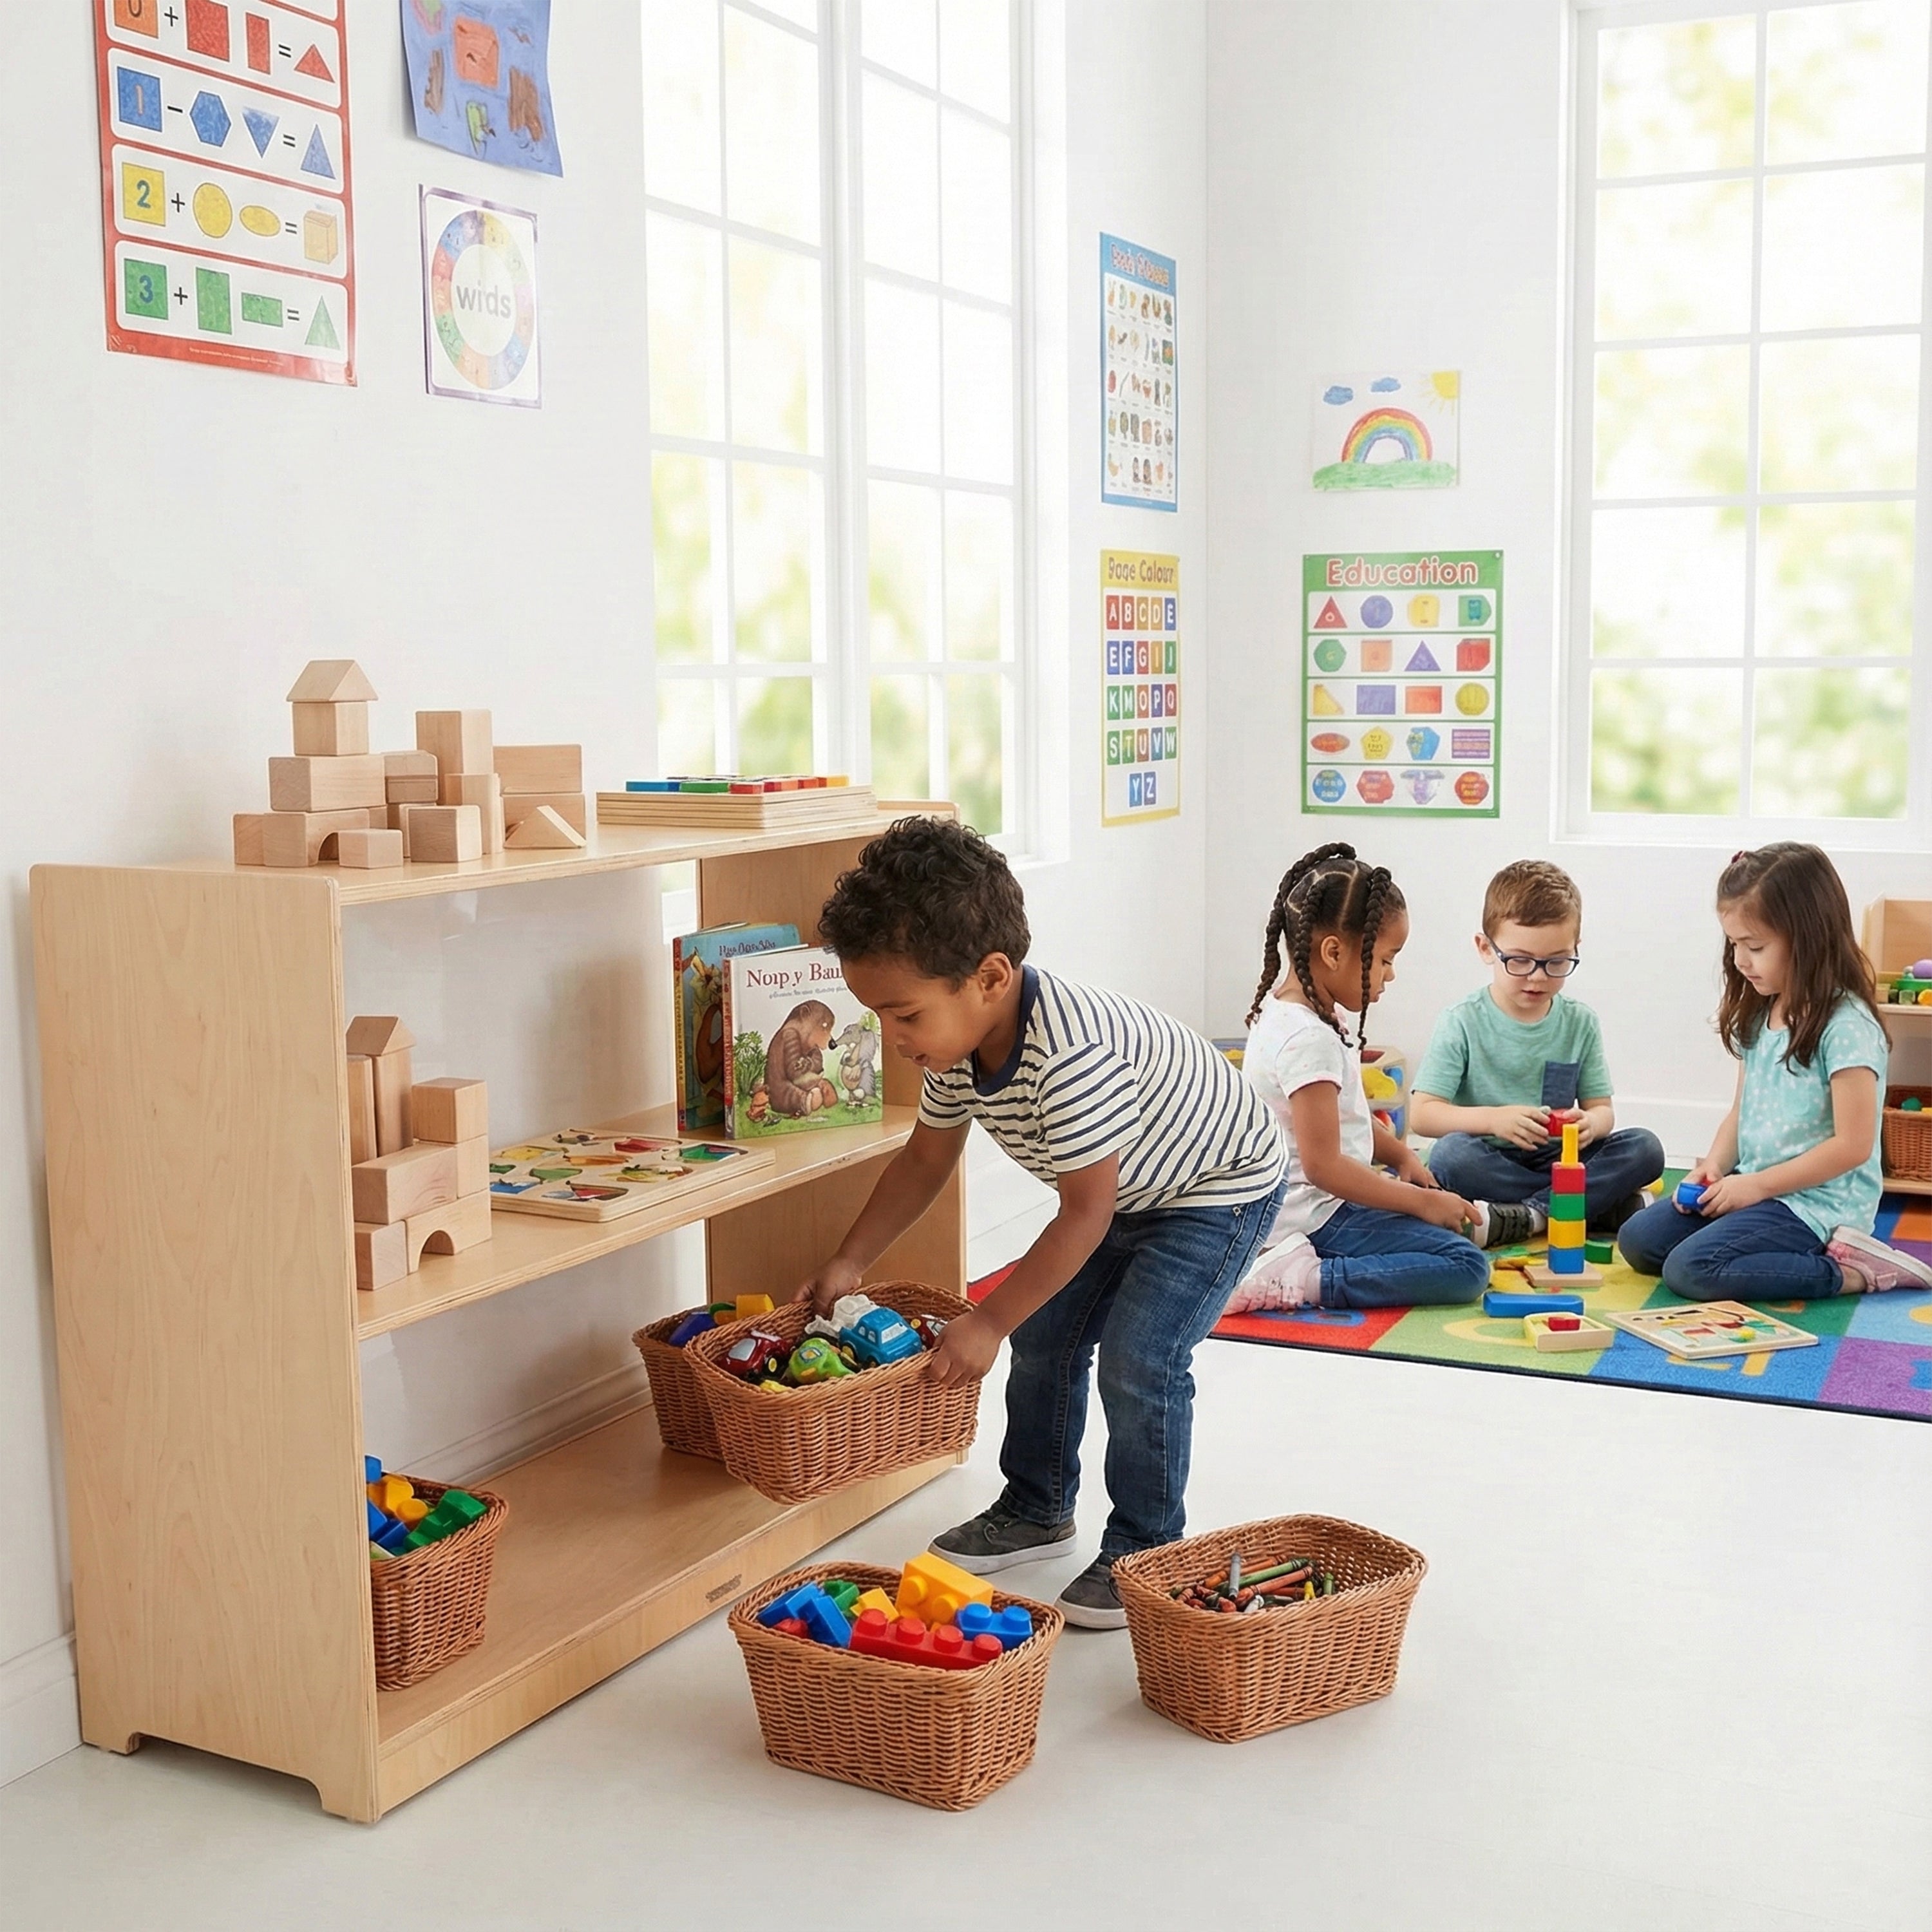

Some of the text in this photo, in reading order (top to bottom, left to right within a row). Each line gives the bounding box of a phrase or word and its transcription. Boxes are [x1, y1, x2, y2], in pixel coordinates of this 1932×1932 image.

[137, 180, 151, 209] 2
[139, 274, 154, 304] 3
[1327, 556, 1479, 587] Education
[1109, 602, 1173, 624] A B C D E
[1110, 646, 1117, 667] E
[1124, 646, 1132, 667] F
[1139, 647, 1147, 667] G
[1110, 690, 1119, 712] K
[1153, 690, 1160, 709] P
[1110, 731, 1175, 758] S T U V W
[1132, 777, 1154, 802] Y Z
